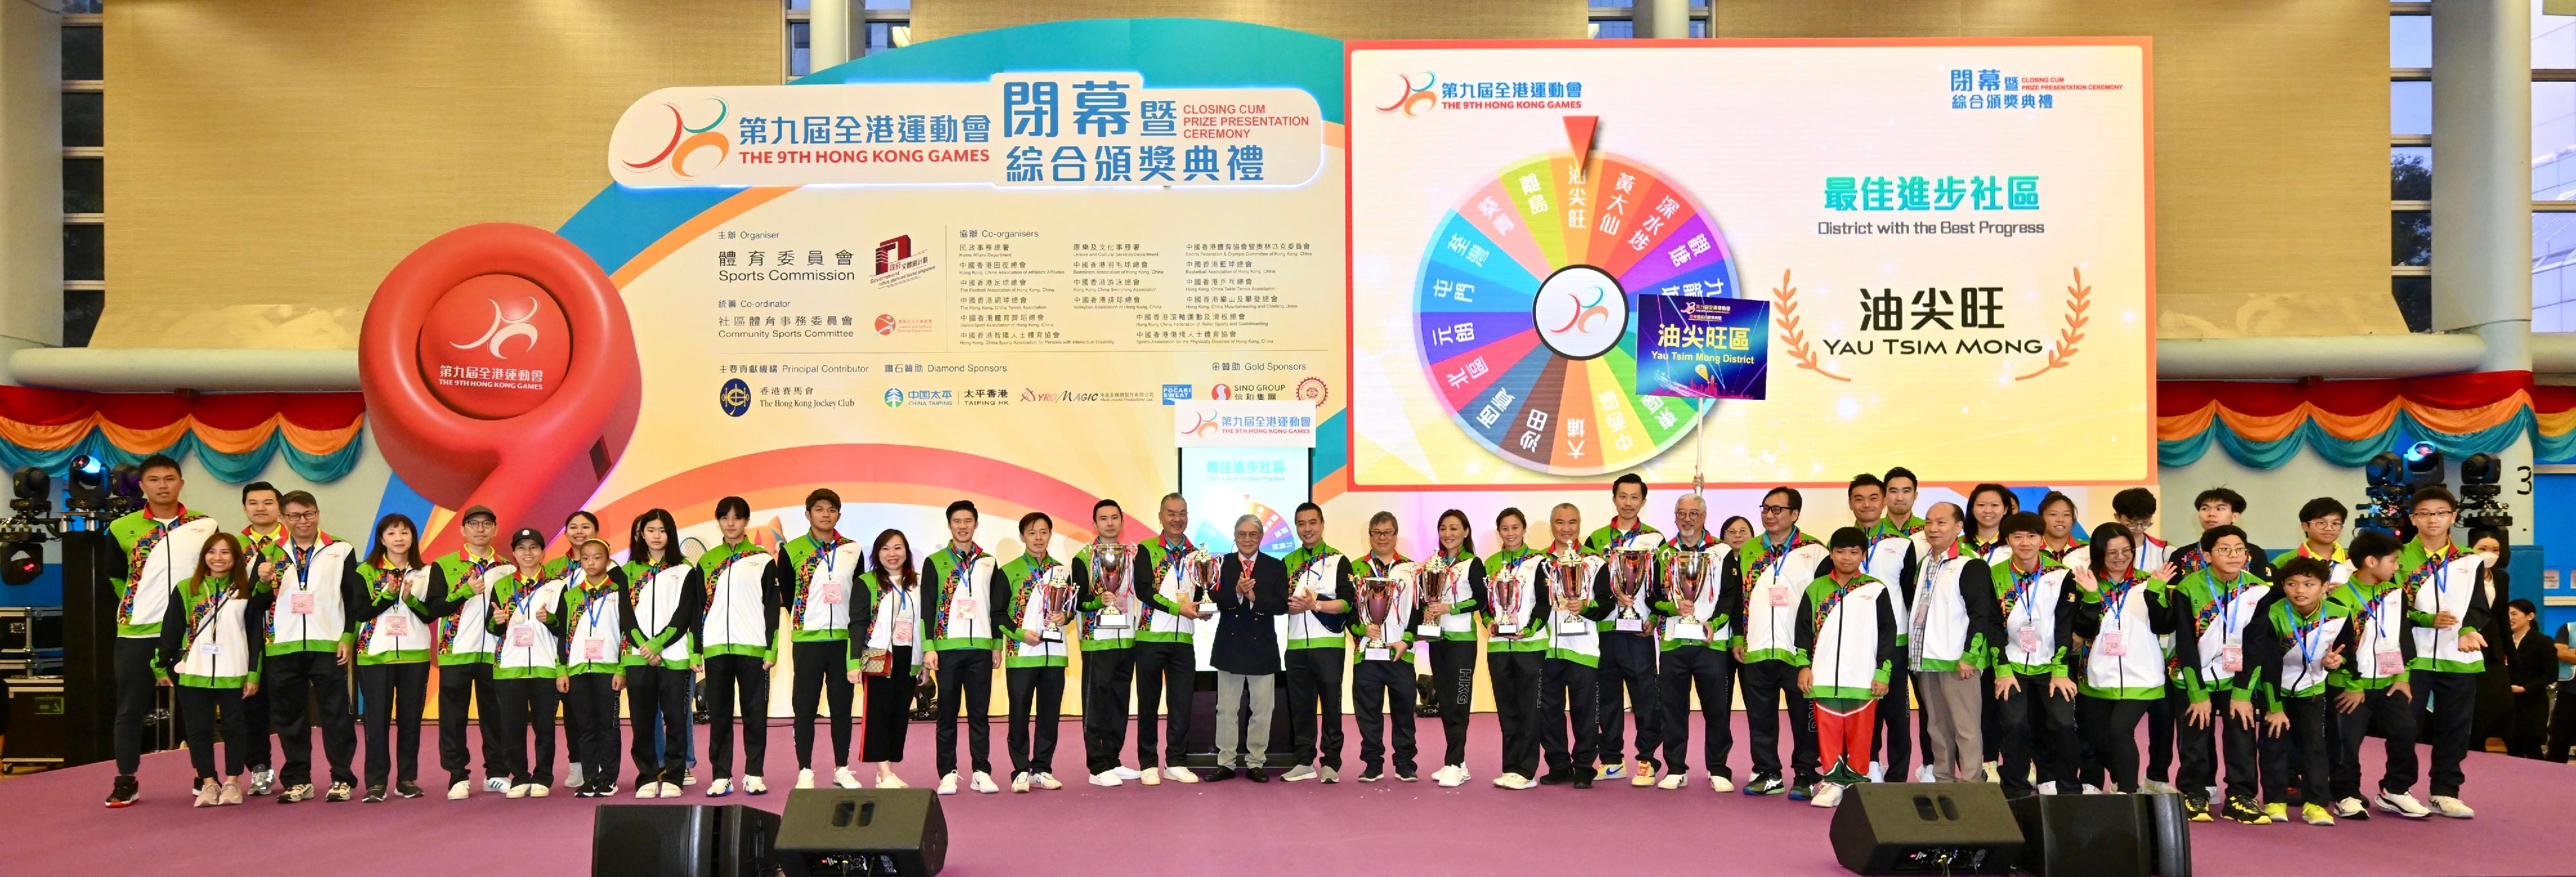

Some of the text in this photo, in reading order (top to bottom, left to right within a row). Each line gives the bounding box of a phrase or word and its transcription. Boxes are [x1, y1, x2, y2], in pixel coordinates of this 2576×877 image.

[1441, 81, 1584, 99] 第九屆全港運動會
[1441, 100, 1582, 109] THE 9TH HONG KONG GAMES
[1951, 93, 2055, 109] 綜合頒獎典禮
[1184, 105, 1265, 114] CLOSING CUM
[739, 114, 991, 145] 第九屆全港運動會
[1184, 117, 1309, 126] PRIZE PRESENTATION
[1184, 129, 1250, 138] CEREMONY
[739, 149, 989, 164] THE 9TH HONG KONG GAMES
[1006, 147, 1264, 184] 綜合頒獎典禮
[1520, 173, 1548, 215] 離島
[1568, 164, 1587, 229] 油尖旺
[1823, 174, 2041, 212] 最佳進步社區
[1600, 171, 1636, 236] 黃大仙
[1477, 199, 1515, 236] 葵青
[719, 231, 735, 240] 主辦
[741, 231, 779, 240] Organiser
[959, 229, 978, 238] 協辦
[982, 230, 1038, 239] Co-organisers
[1819, 221, 2044, 237] District with the Best Progress
[719, 250, 854, 266] 體育委員會
[1447, 232, 1490, 268] 荃灣
[1668, 232, 1711, 269] 觀塘
[719, 270, 854, 283] Sports Commission
[870, 272, 900, 283] Government
[1433, 279, 1475, 303] 屯門
[1860, 287, 2004, 330] 油尖旺
[719, 316, 852, 326] 社區體育事務委員會
[719, 330, 769, 339] Community
[773, 330, 801, 339] Sports
[1432, 321, 1475, 345] 元朗
[1658, 323, 1750, 350] 油尖旺區
[1652, 351, 1754, 364] Yau Tsim Mong District
[439, 364, 544, 382] 第九屆全港運動會
[783, 365, 818, 374] Principal
[968, 364, 1007, 373] Sponsors
[1212, 362, 1242, 371] 金贊助
[1267, 363, 1306, 372] Sponsors
[1446, 355, 1489, 388] 北區
[907, 390, 953, 400] 中国太平
[775, 400, 793, 408] Hong
[795, 400, 811, 409] Kong
[813, 399, 836, 408] Jockey
[1476, 386, 1516, 429] 西貢
[1641, 393, 1678, 431] 東區
[1221, 416, 1311, 427] 第九屆全港運動會
[1598, 390, 1633, 453] 中西區
[1520, 408, 1548, 453] 沙田
[1567, 419, 1586, 459] 大埔
[2517, 466, 2532, 495] 3
[1457, 668, 1472, 704] HKG
